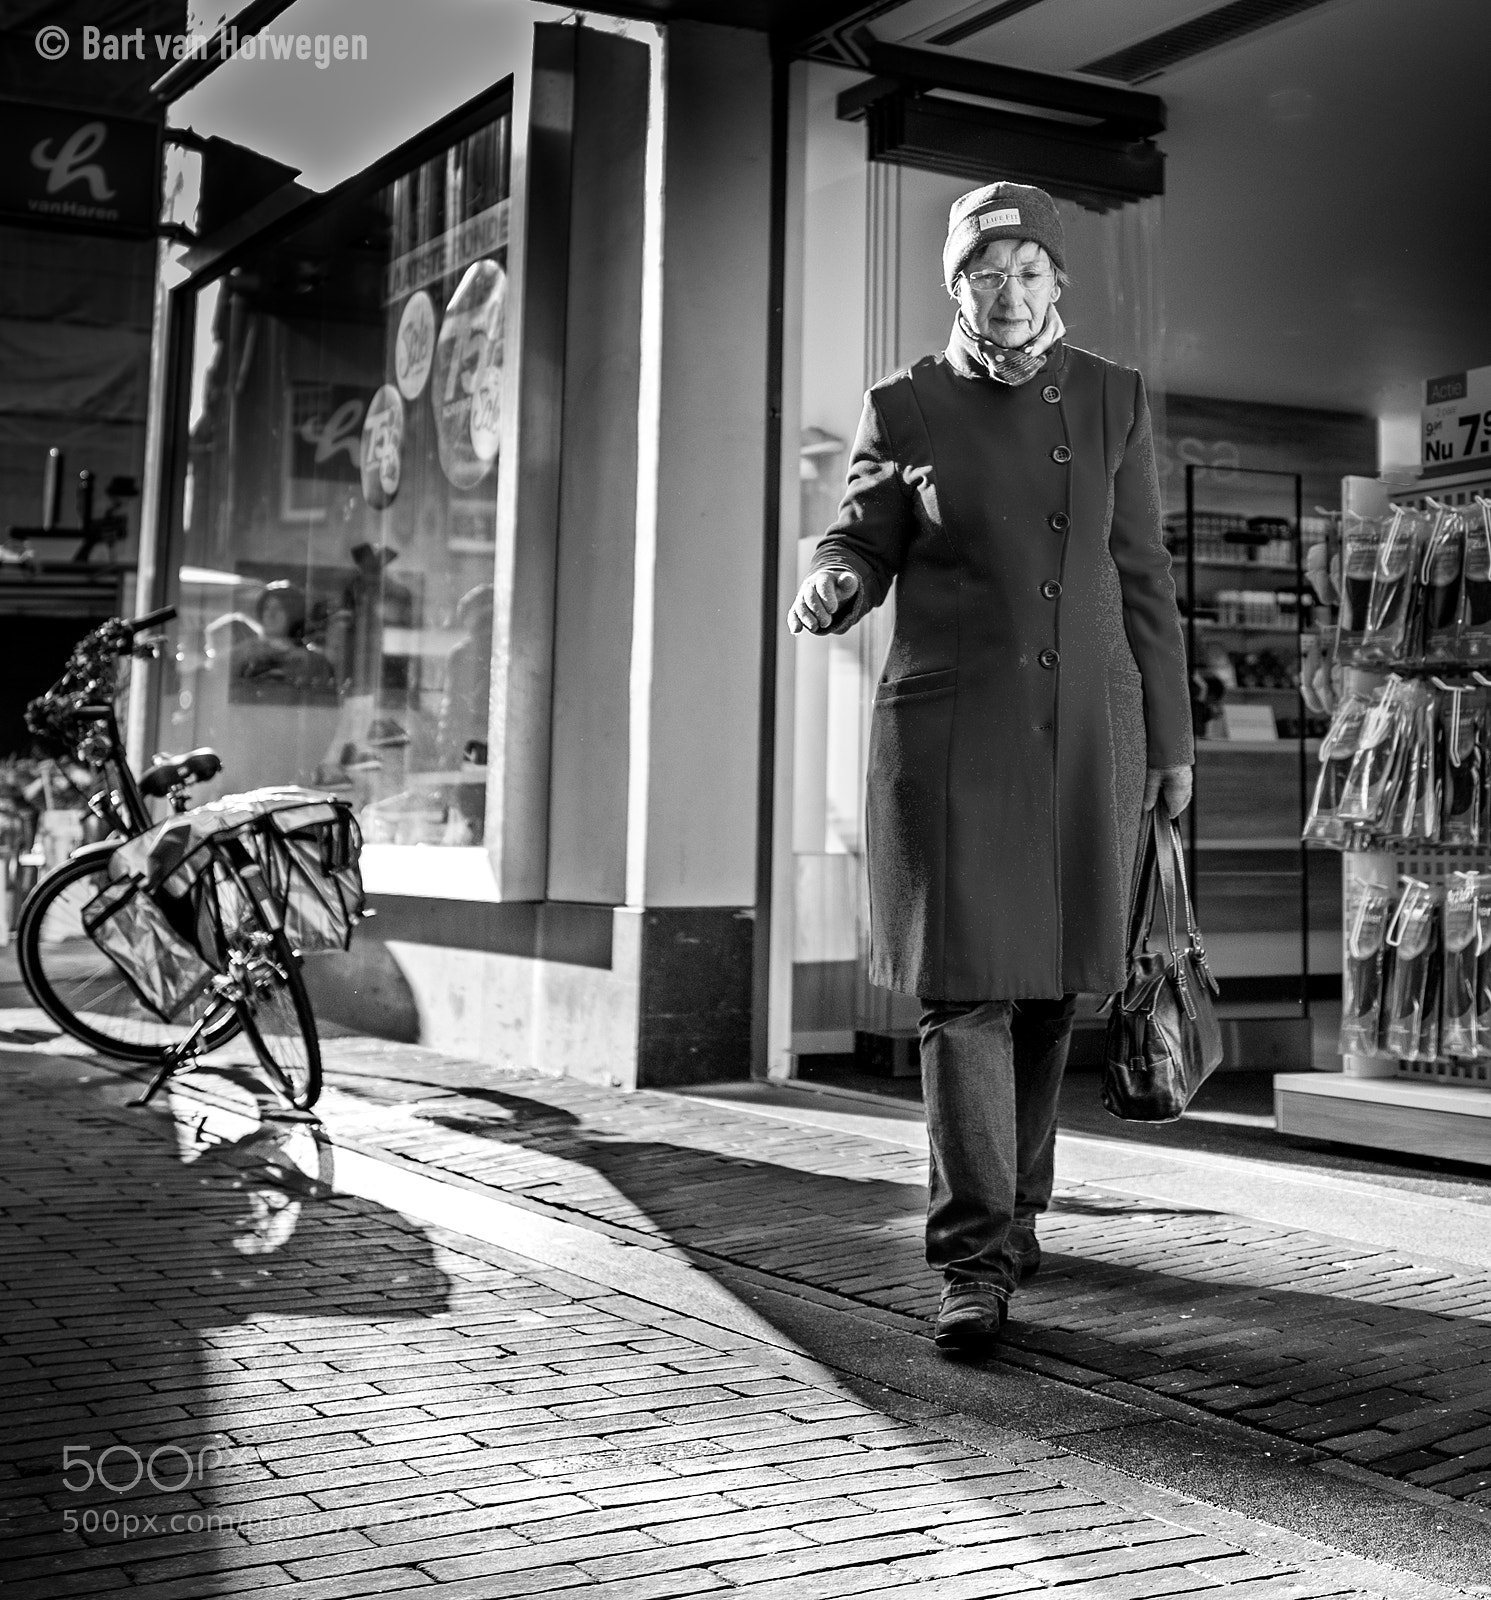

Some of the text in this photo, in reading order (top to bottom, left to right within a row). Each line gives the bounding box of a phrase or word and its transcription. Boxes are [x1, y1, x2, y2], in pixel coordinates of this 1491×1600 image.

[27, 198, 119, 221] vanHaren
[454, 209, 508, 264] ONDE
[1430, 382, 1463, 401] Actie
[1425, 440, 1453, 461] Nu
